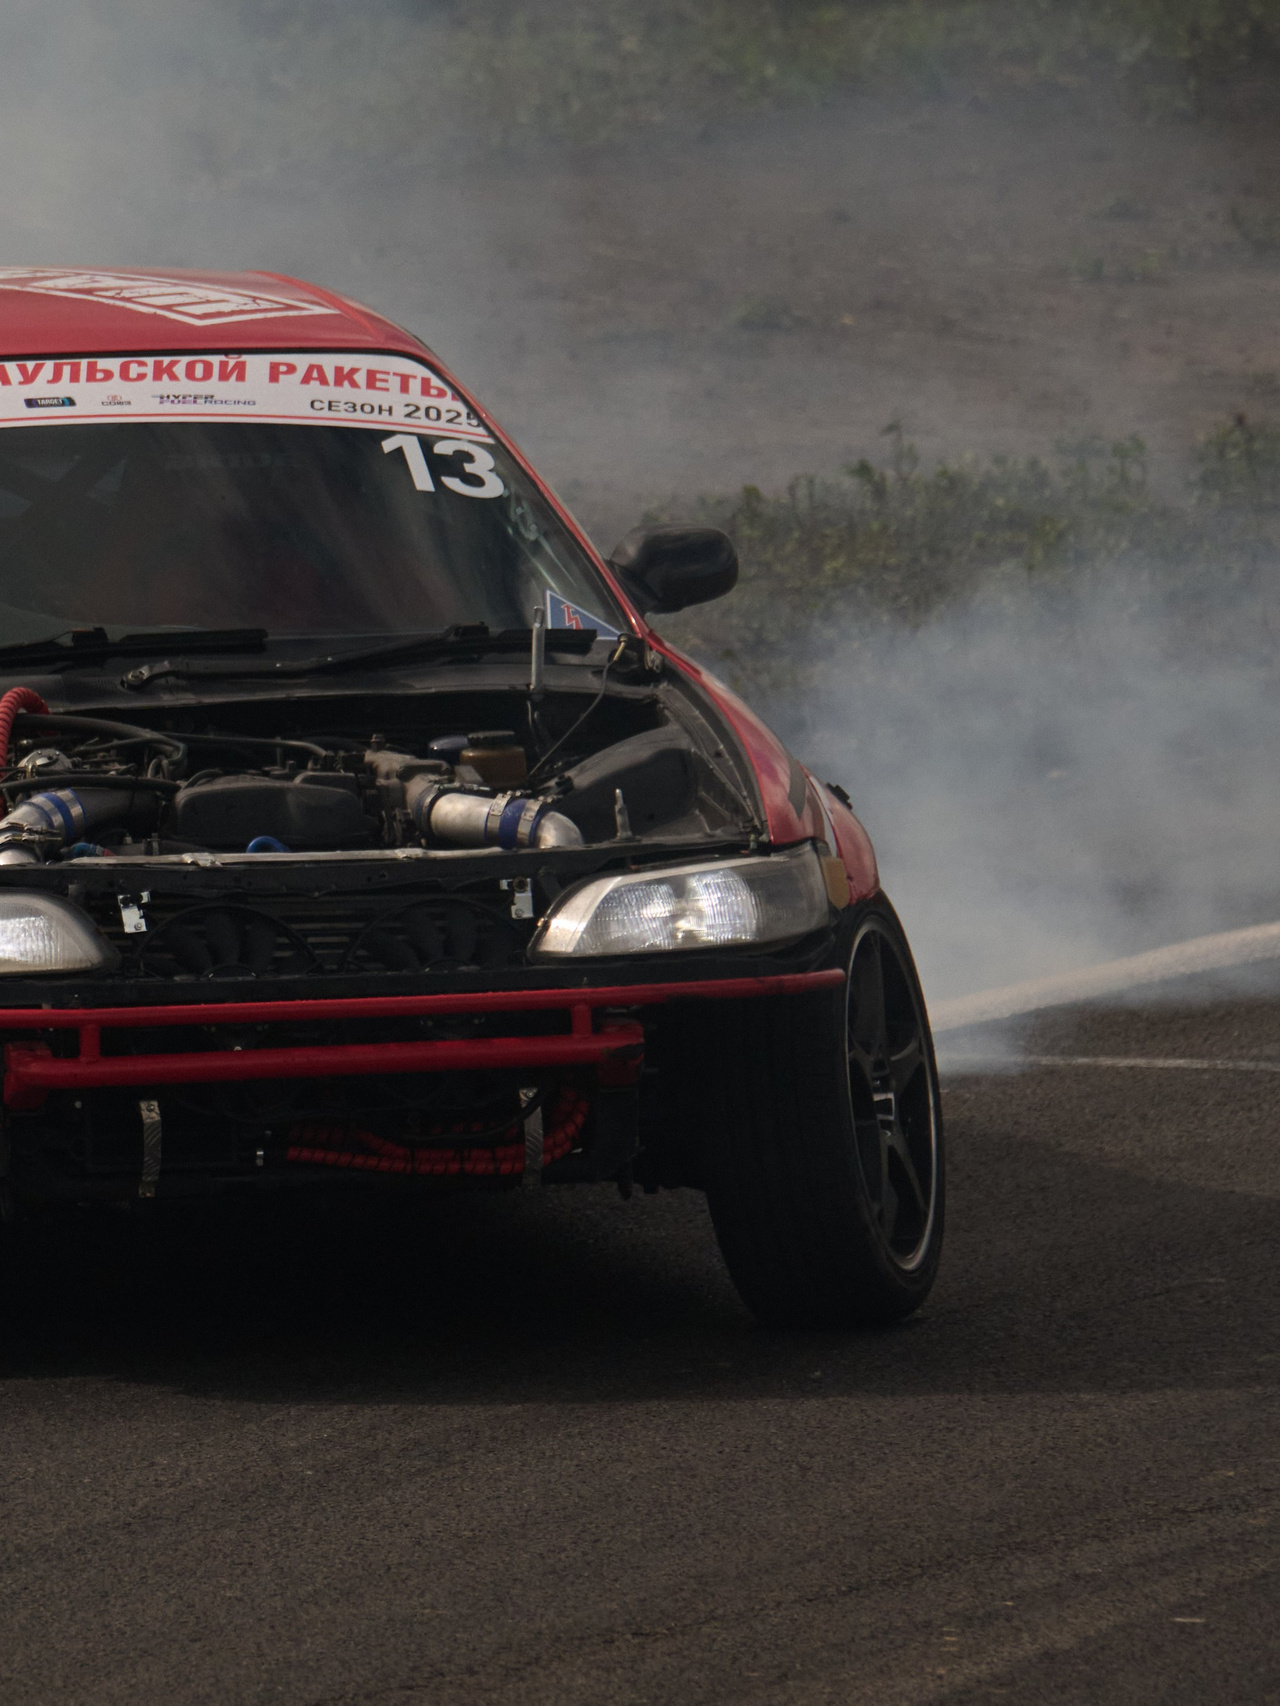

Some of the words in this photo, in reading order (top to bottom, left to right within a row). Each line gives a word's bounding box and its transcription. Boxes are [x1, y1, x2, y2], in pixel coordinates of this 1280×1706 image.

[268, 361, 459, 402] РАКЕТЫ
[309, 399, 394, 418] СЕЗОН
[403, 403, 482, 428] 2025
[381, 433, 505, 499] 13
